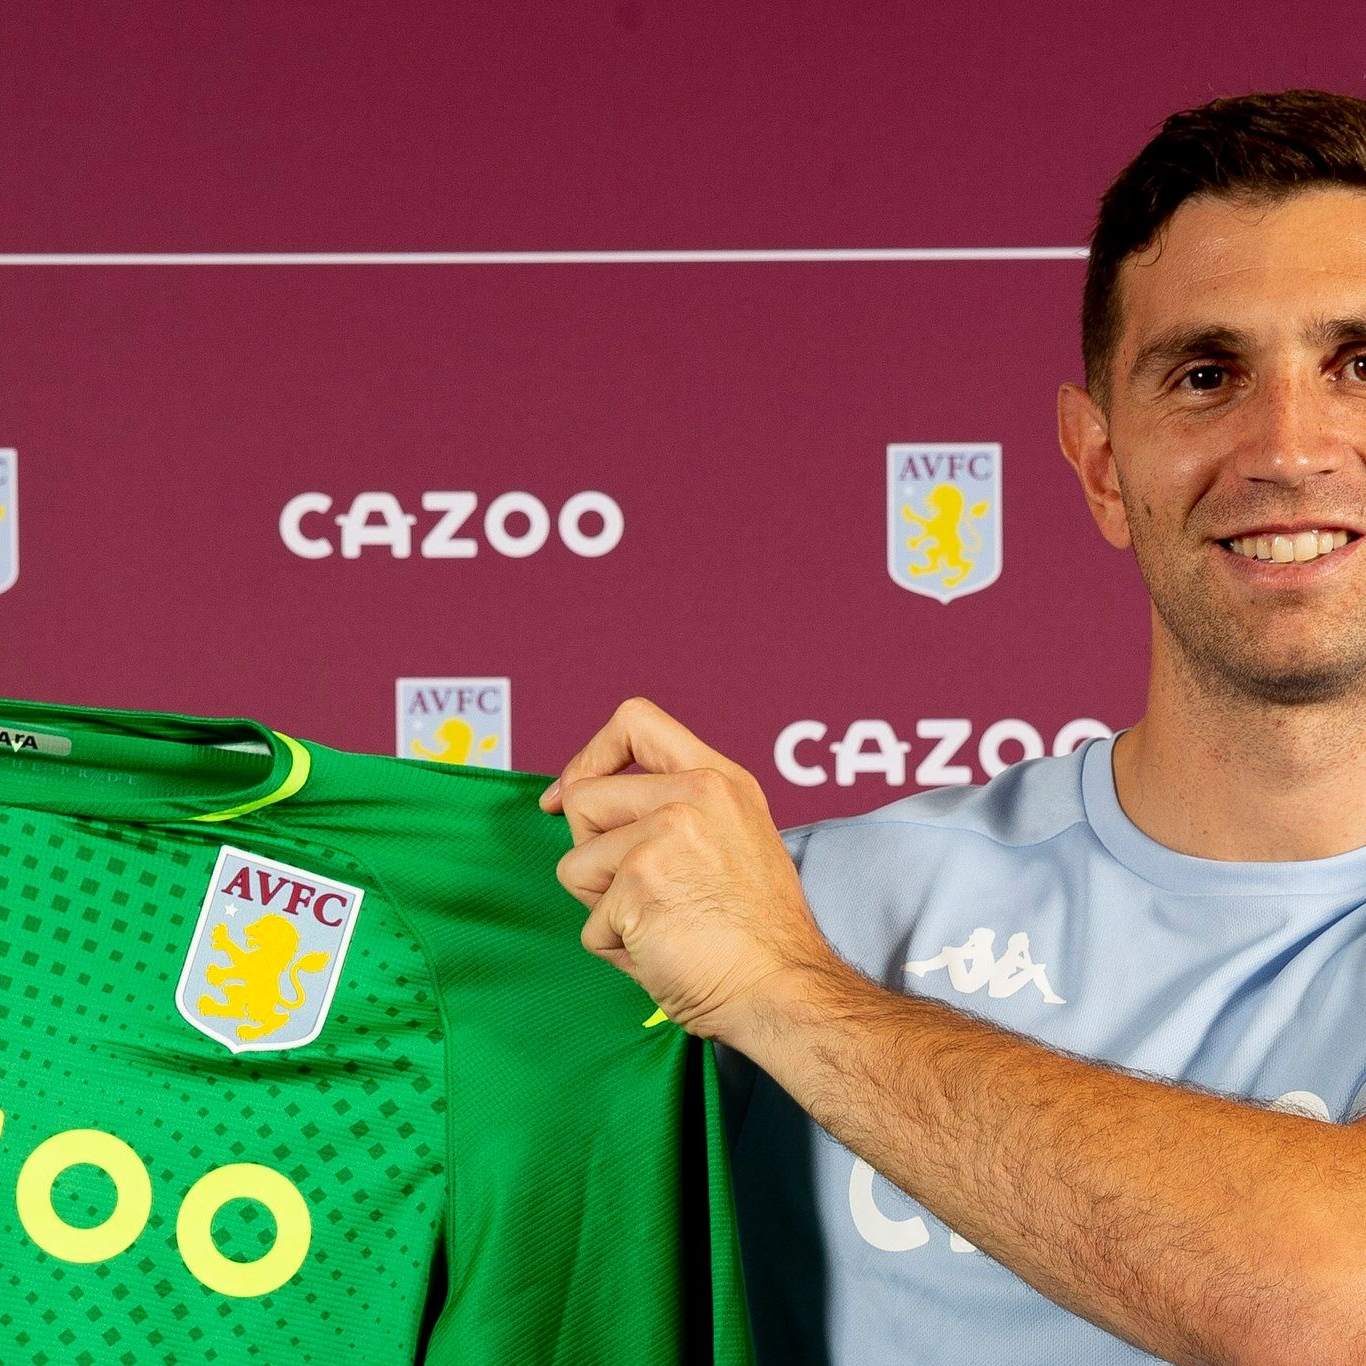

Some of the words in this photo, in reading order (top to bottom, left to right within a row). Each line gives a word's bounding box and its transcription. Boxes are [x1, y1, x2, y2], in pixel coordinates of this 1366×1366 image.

[900, 452, 993, 481] AVFC
[278, 490, 625, 560] CAZOO
[409, 688, 502, 716] AVFC
[220, 865, 350, 929] AVFC
